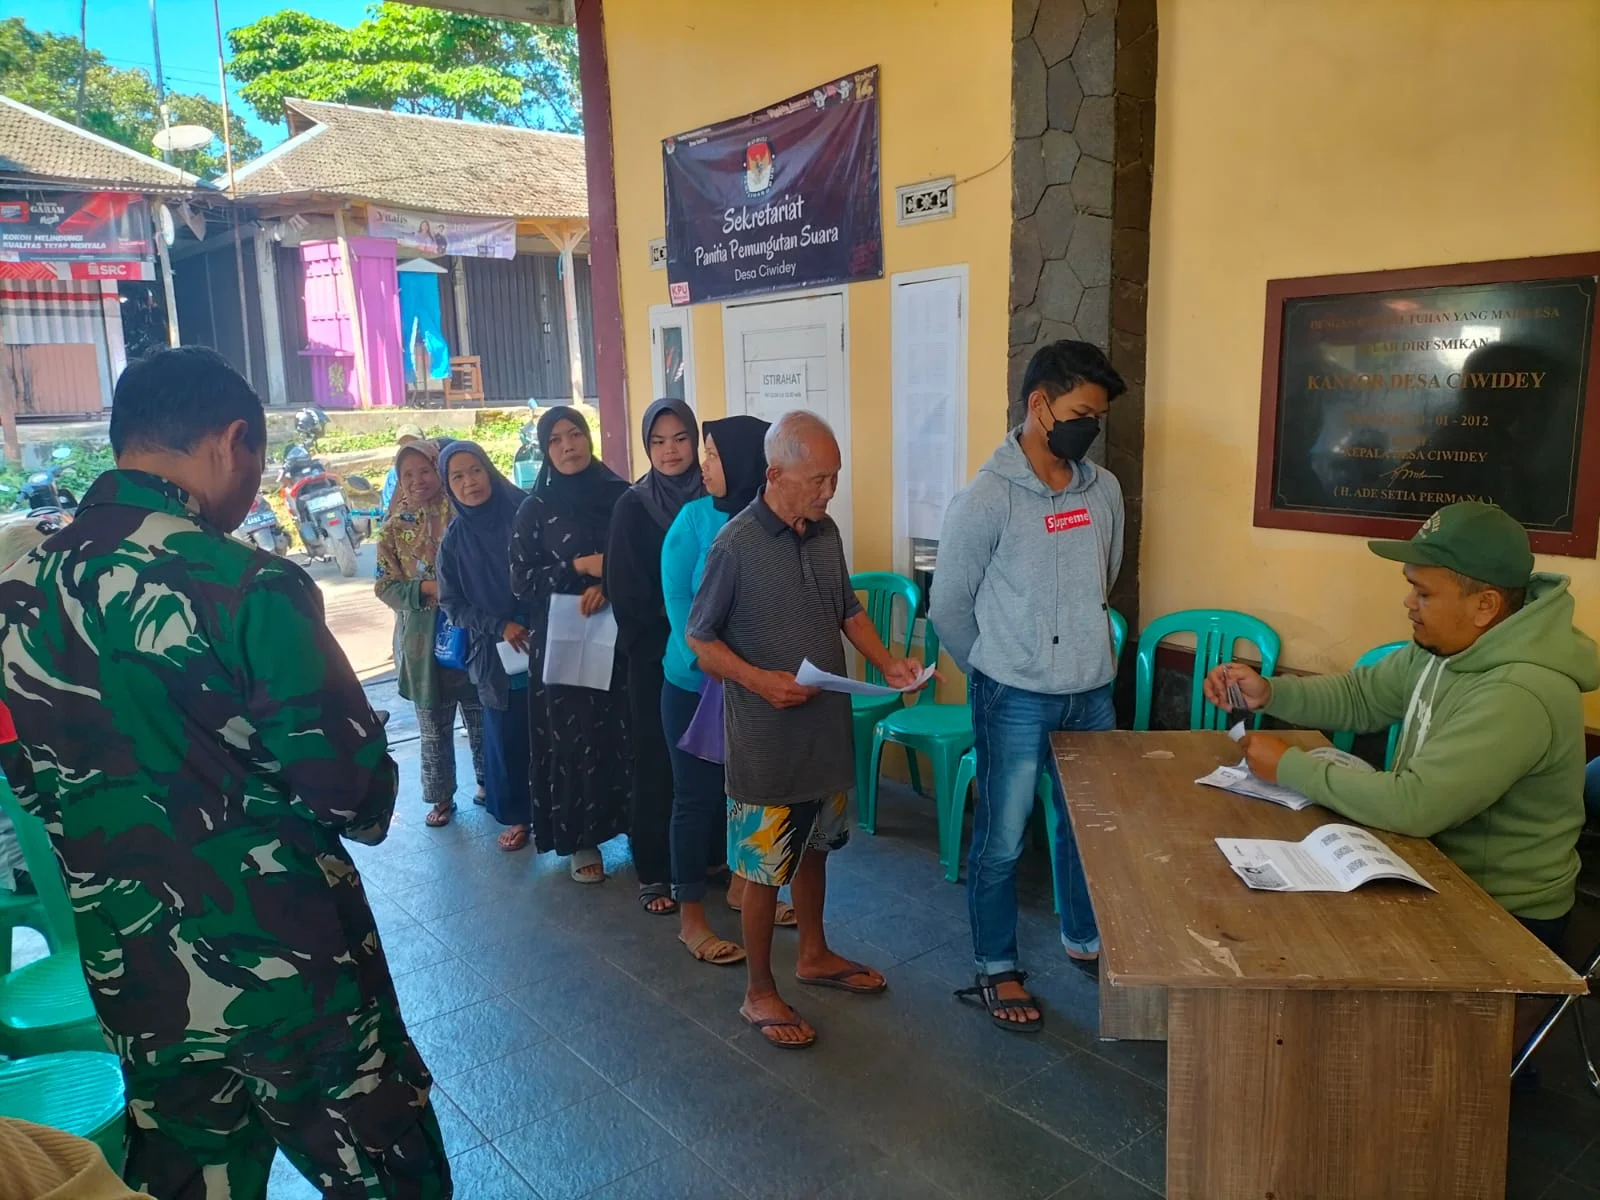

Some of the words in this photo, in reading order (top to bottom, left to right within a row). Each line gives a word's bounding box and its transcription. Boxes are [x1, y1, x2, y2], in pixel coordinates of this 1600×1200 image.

[722, 194, 805, 234] Sekretariat
[694, 243, 728, 266] Panitia
[728, 234, 798, 260] Pemungutan
[799, 224, 839, 247] Suara
[100, 265, 127, 275] SRC
[734, 267, 757, 281] Desa
[758, 262, 797, 277] Ciwidey
[671, 285, 688, 296] KPU
[1409, 313, 1450, 324] TUHAN
[1453, 310, 1488, 322] YANG
[763, 373, 801, 385] ISTIRAHAT
[1391, 373, 1440, 389] DESA
[1446, 371, 1547, 389] CIWIDEY
[1461, 415, 1489, 426] 2012
[1343, 448, 1386, 461] KEPAL
[1390, 450, 1425, 461] SA
[1427, 451, 1488, 463] CIWIDEY
[1340, 487, 1352, 497] H.
[1354, 487, 1379, 498] ADE
[1380, 490, 1417, 502] SETIA
[1419, 492, 1485, 505] PERMANA
[1047, 513, 1090, 529] Supreme
